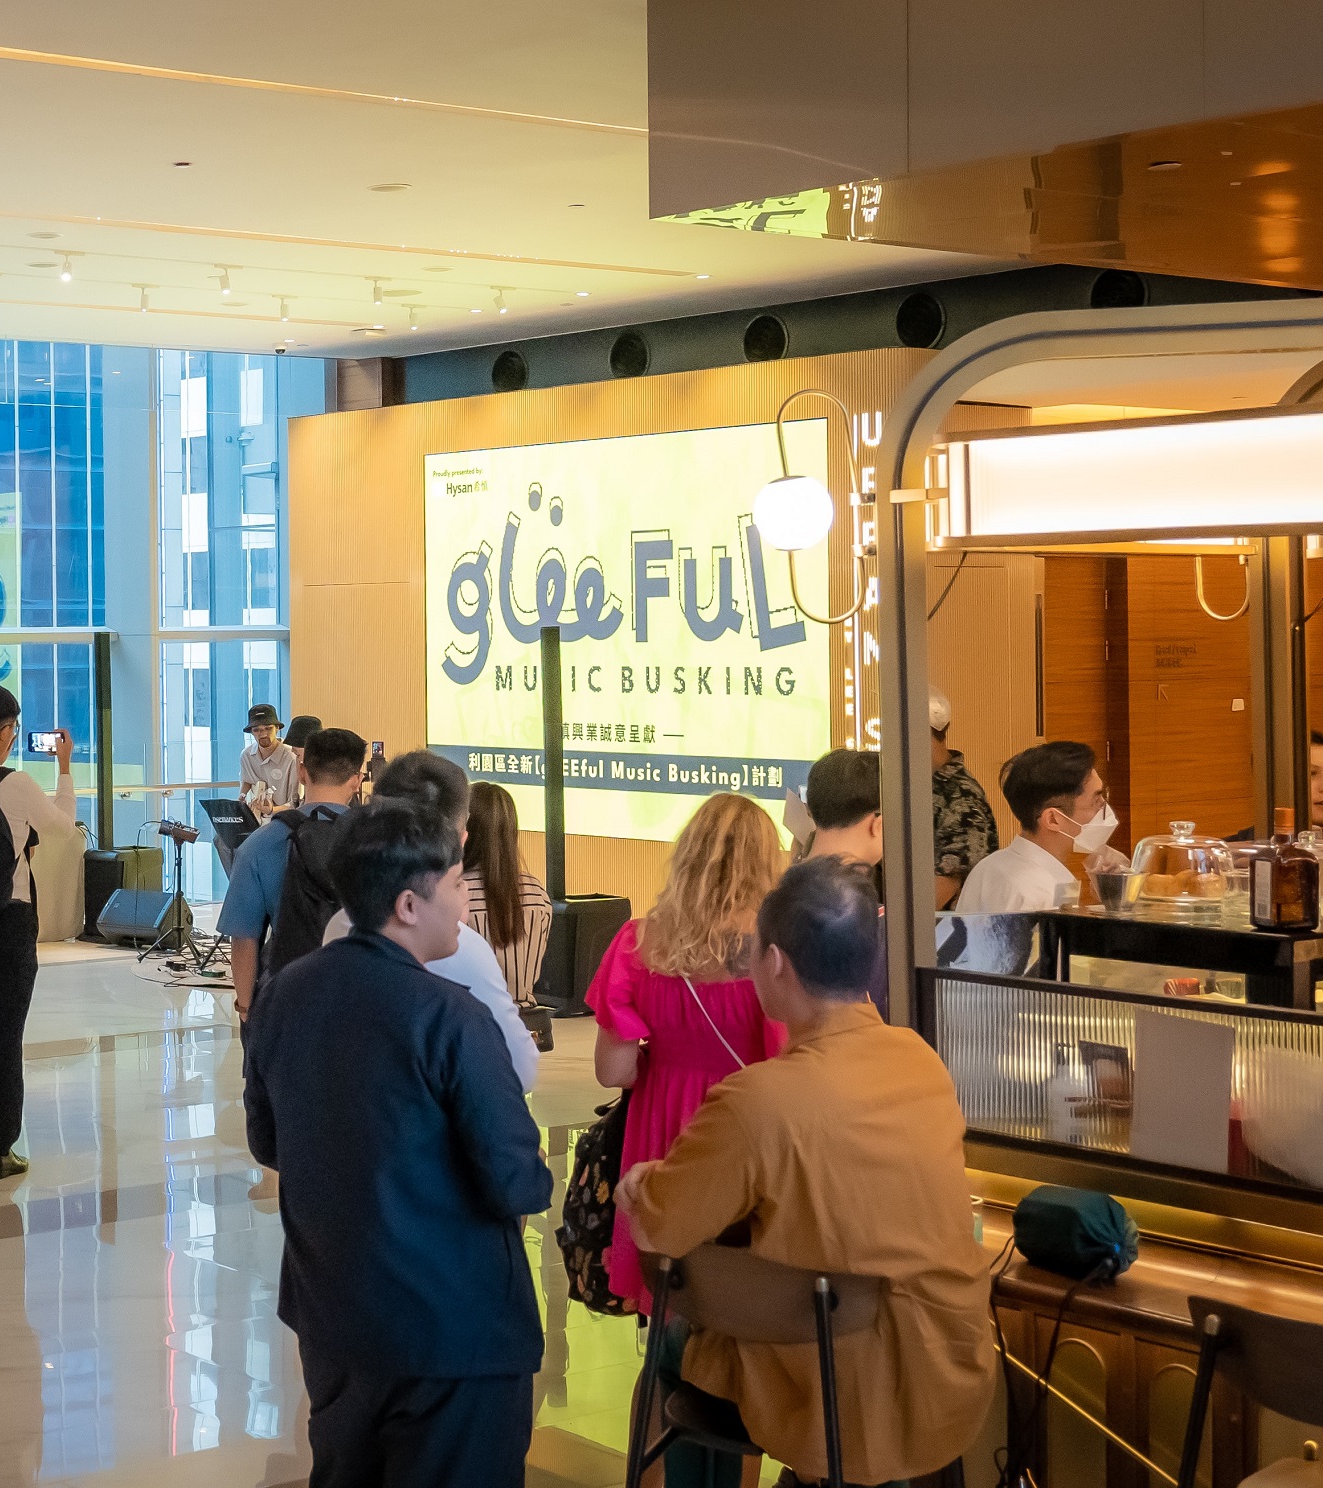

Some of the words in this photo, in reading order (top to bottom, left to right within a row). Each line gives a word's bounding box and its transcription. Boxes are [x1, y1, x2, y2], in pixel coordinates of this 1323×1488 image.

[432, 469, 451, 478] Proudly
[451, 467, 475, 478] presented
[446, 482, 473, 497] Hysan
[494, 665, 602, 693] MUIC
[620, 665, 796, 696] BUSKING
[610, 760, 661, 782] Music
